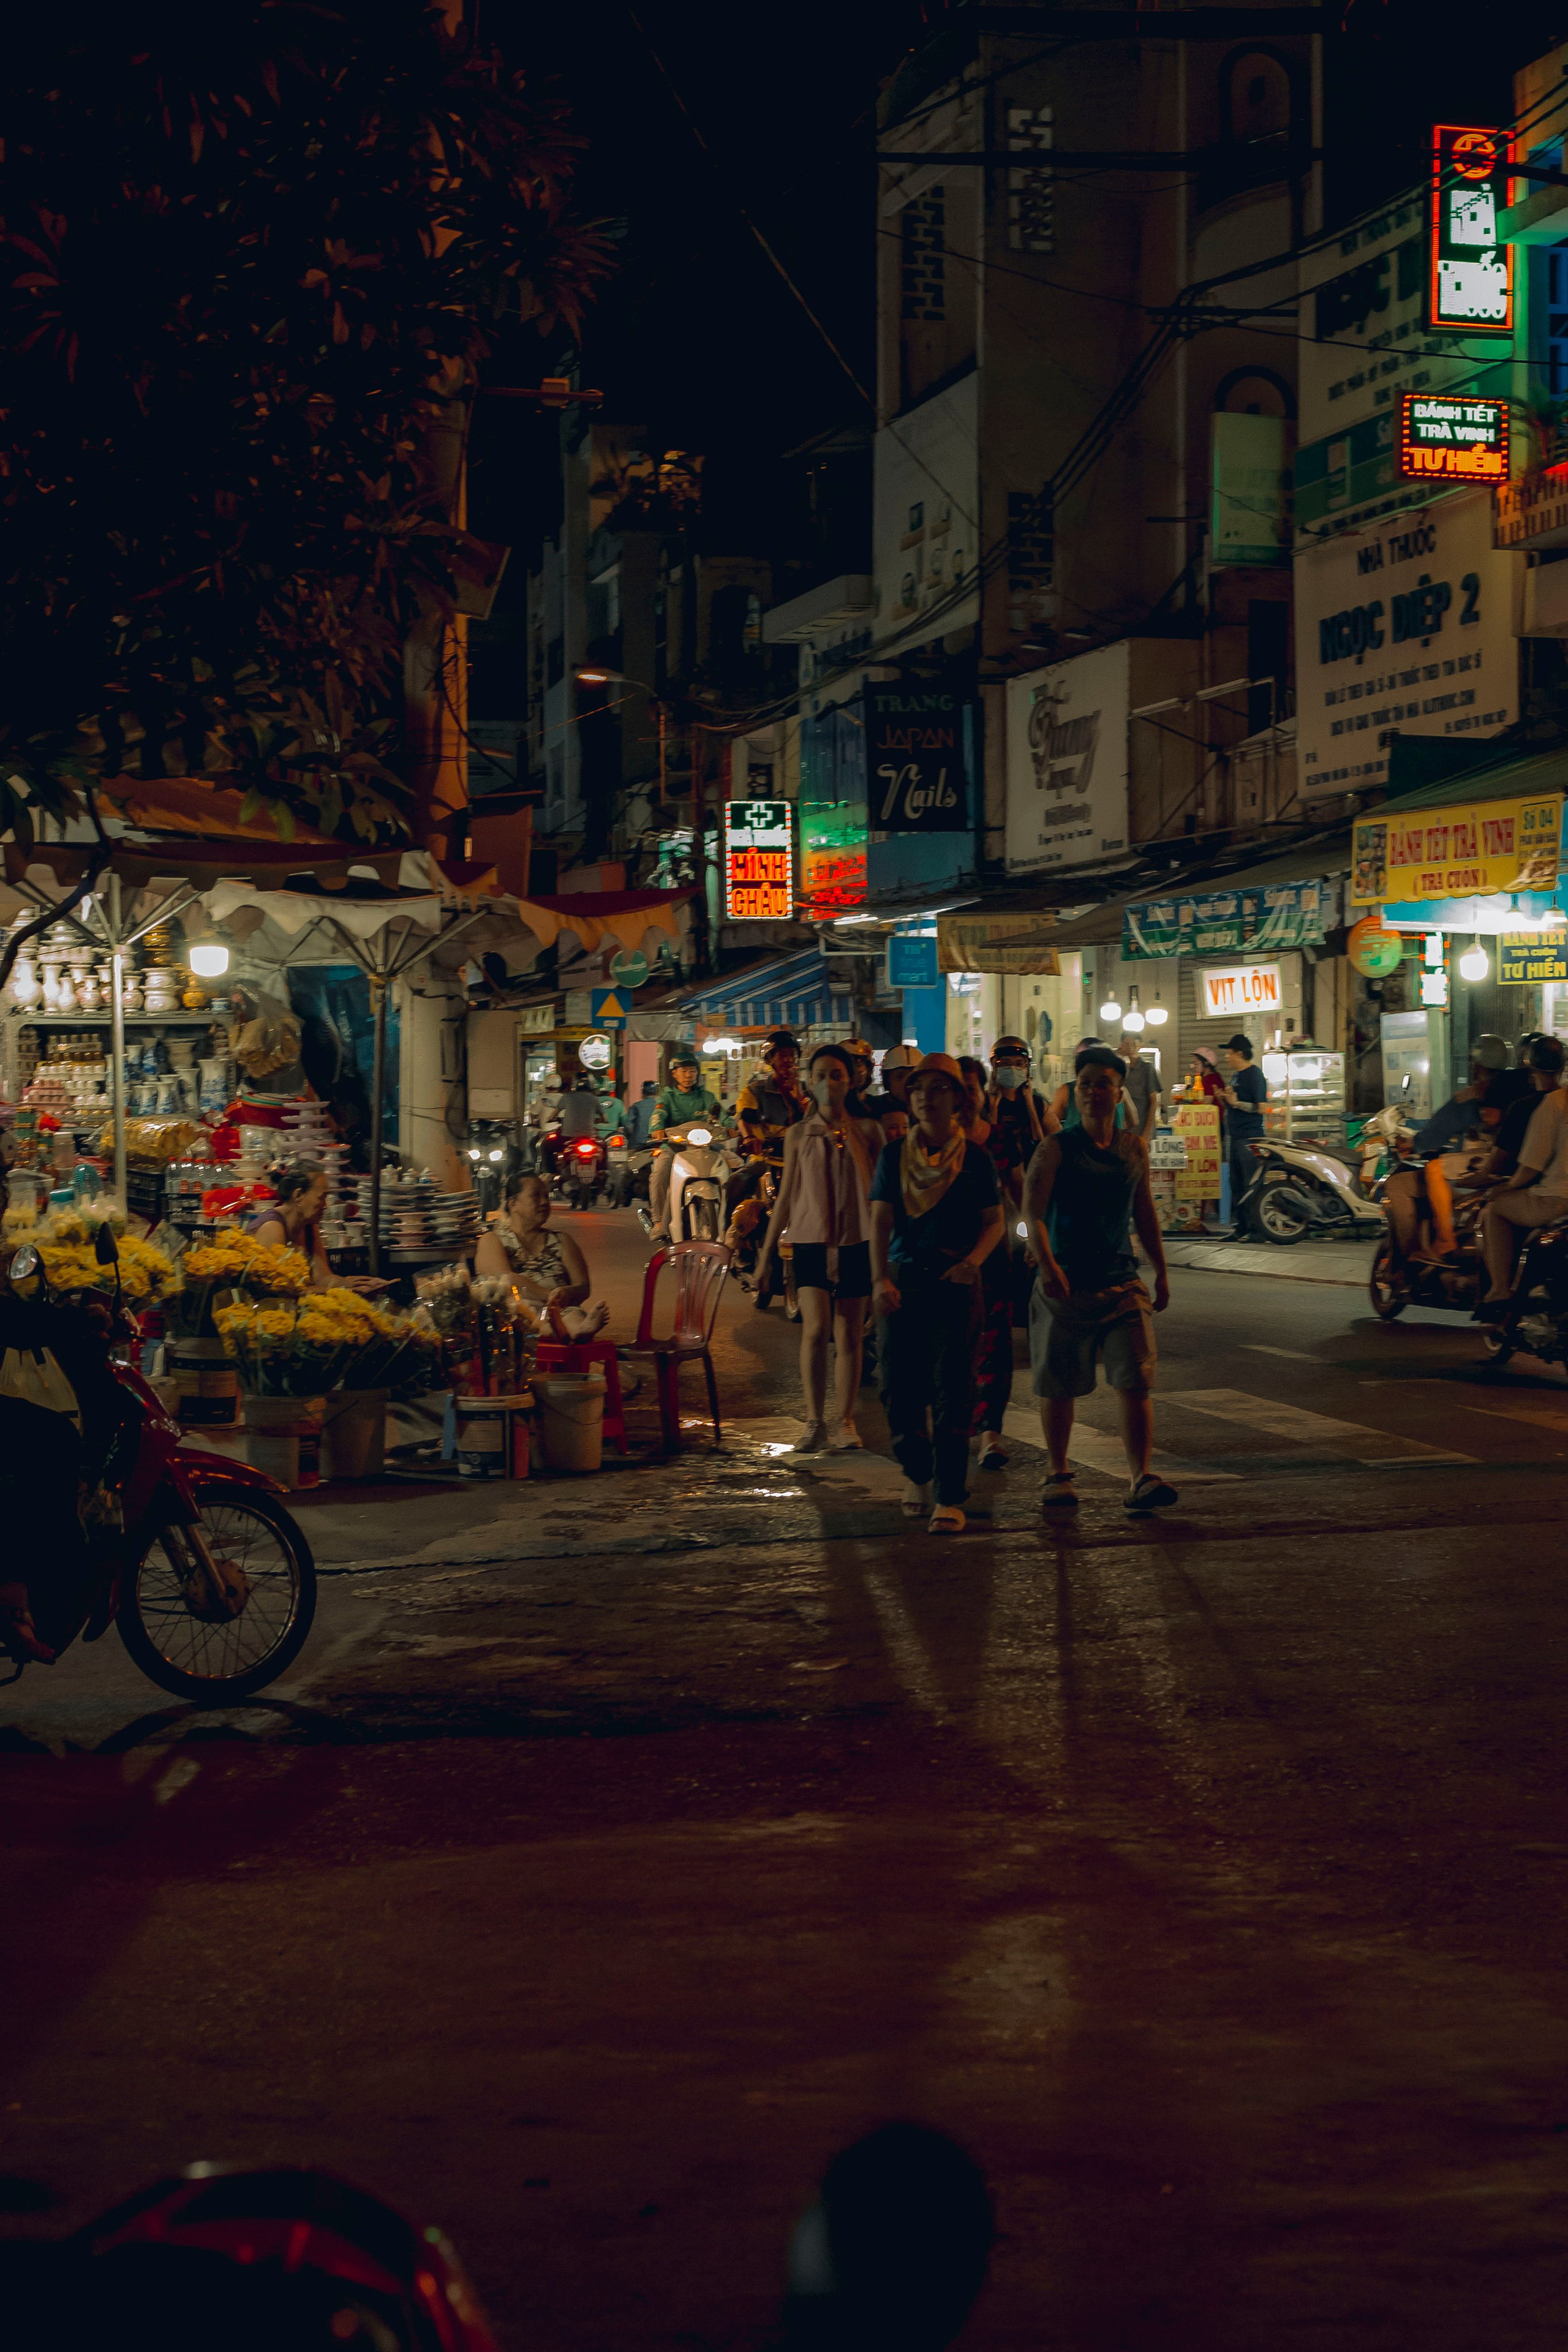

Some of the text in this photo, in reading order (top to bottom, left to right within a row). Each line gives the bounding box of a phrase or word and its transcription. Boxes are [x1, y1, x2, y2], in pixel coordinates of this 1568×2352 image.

[1414, 401, 1498, 423] BÁNH TẾT
[1416, 421, 1495, 442] TRÀ VINH
[1409, 448, 1447, 470] TƯ
[1358, 518, 1437, 576] NHÀ THUỐC
[1319, 572, 1482, 665] NGỌC DIỆP 2
[875, 694, 955, 712] TRANG
[875, 724, 955, 755] JAPAN
[876, 763, 958, 821] Nails
[1389, 812, 1515, 866] BÁNH TẾT TRÀ VINH
[731, 882, 787, 917] CHÂU
[1502, 956, 1567, 979] TƯ HIỂN
[1208, 969, 1278, 1011] VỊT LỘN
